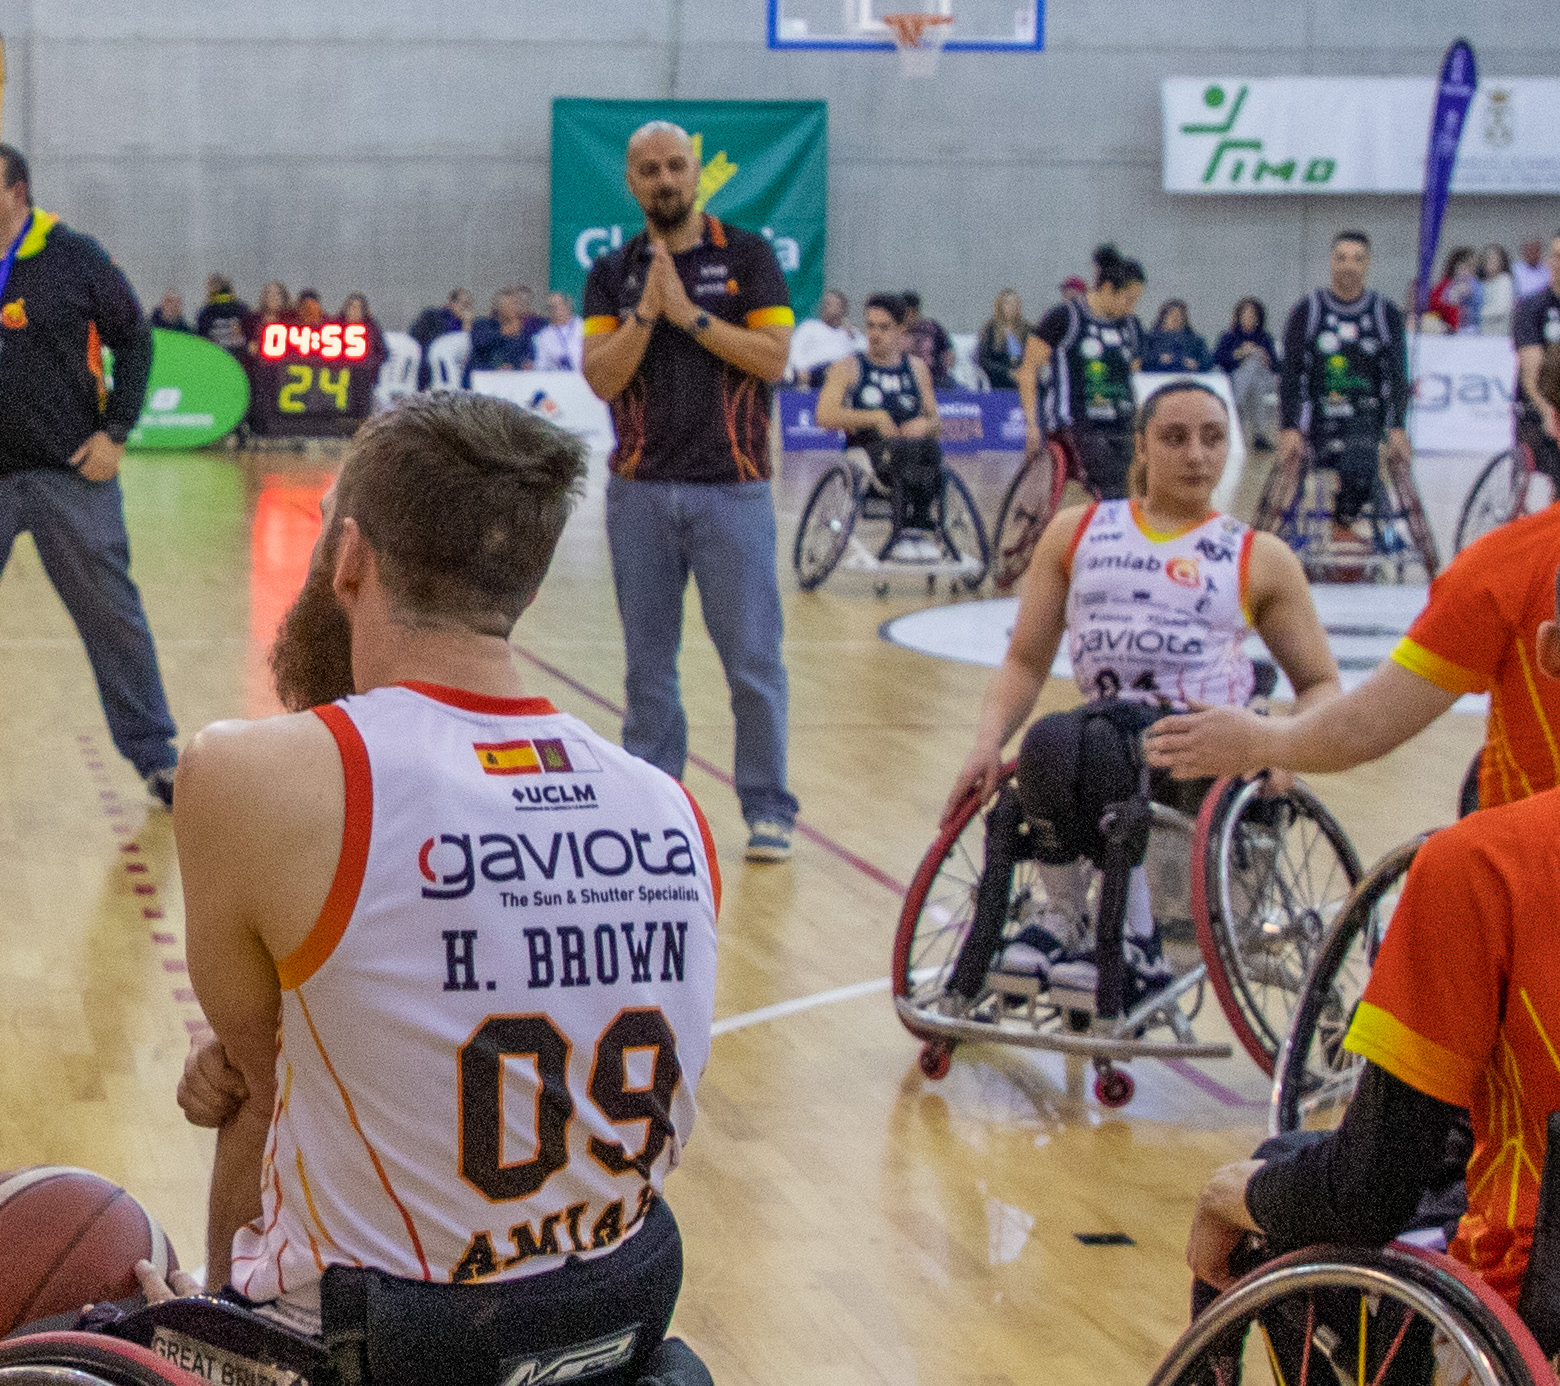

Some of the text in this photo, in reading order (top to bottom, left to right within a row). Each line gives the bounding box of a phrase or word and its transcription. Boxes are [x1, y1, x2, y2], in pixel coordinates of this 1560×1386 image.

[263, 323, 368, 359] 04:55
[278, 365, 350, 412] 24
[524, 784, 597, 803] UCLM
[418, 827, 696, 900] gaviota
[500, 885, 699, 907] The Sun & Shutter Specialists
[442, 921, 688, 992] H. BROWN
[457, 1006, 681, 1203] 09
[153, 1337, 215, 1380] GREAT
